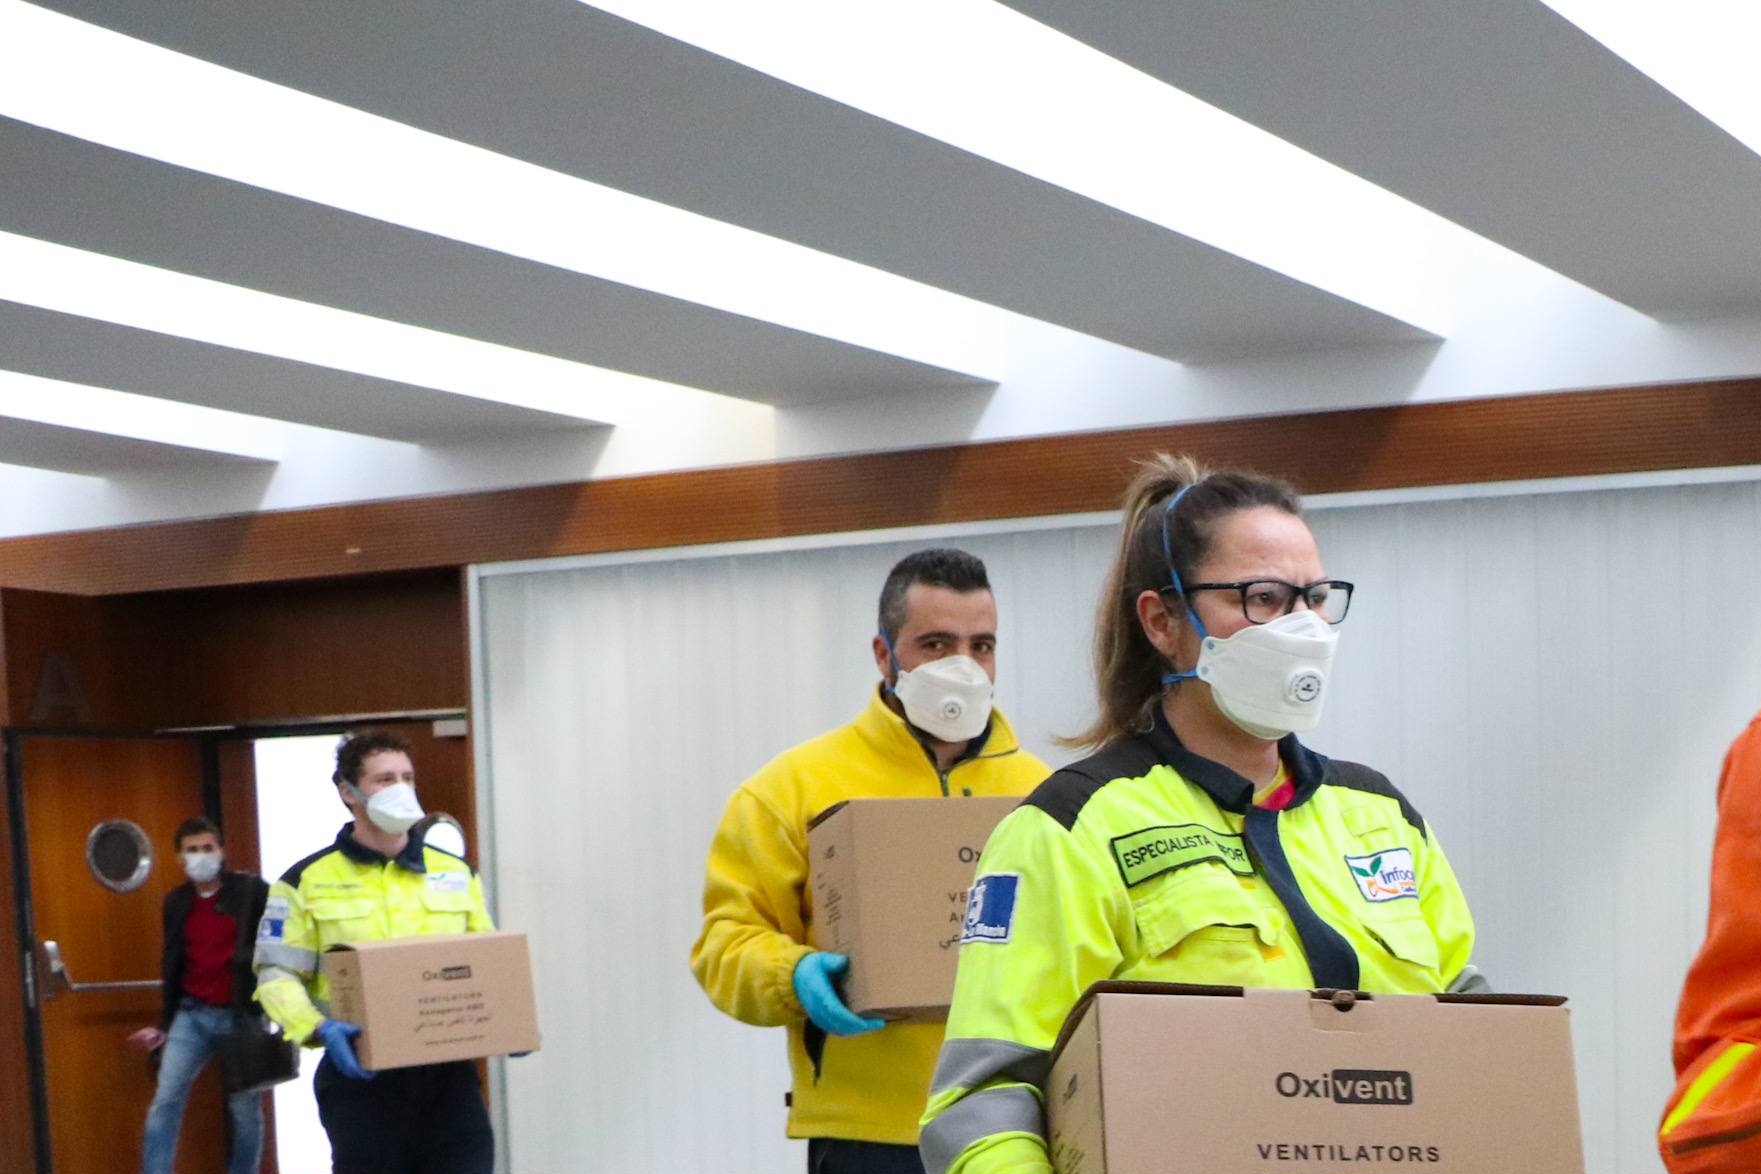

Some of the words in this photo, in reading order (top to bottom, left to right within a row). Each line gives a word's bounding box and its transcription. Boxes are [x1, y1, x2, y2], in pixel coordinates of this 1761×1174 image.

[1123, 834, 1213, 868] ESPECIALISTA
[1275, 1069, 1412, 1105] Oxivent
[1257, 1143, 1440, 1163] VENTILATORS
